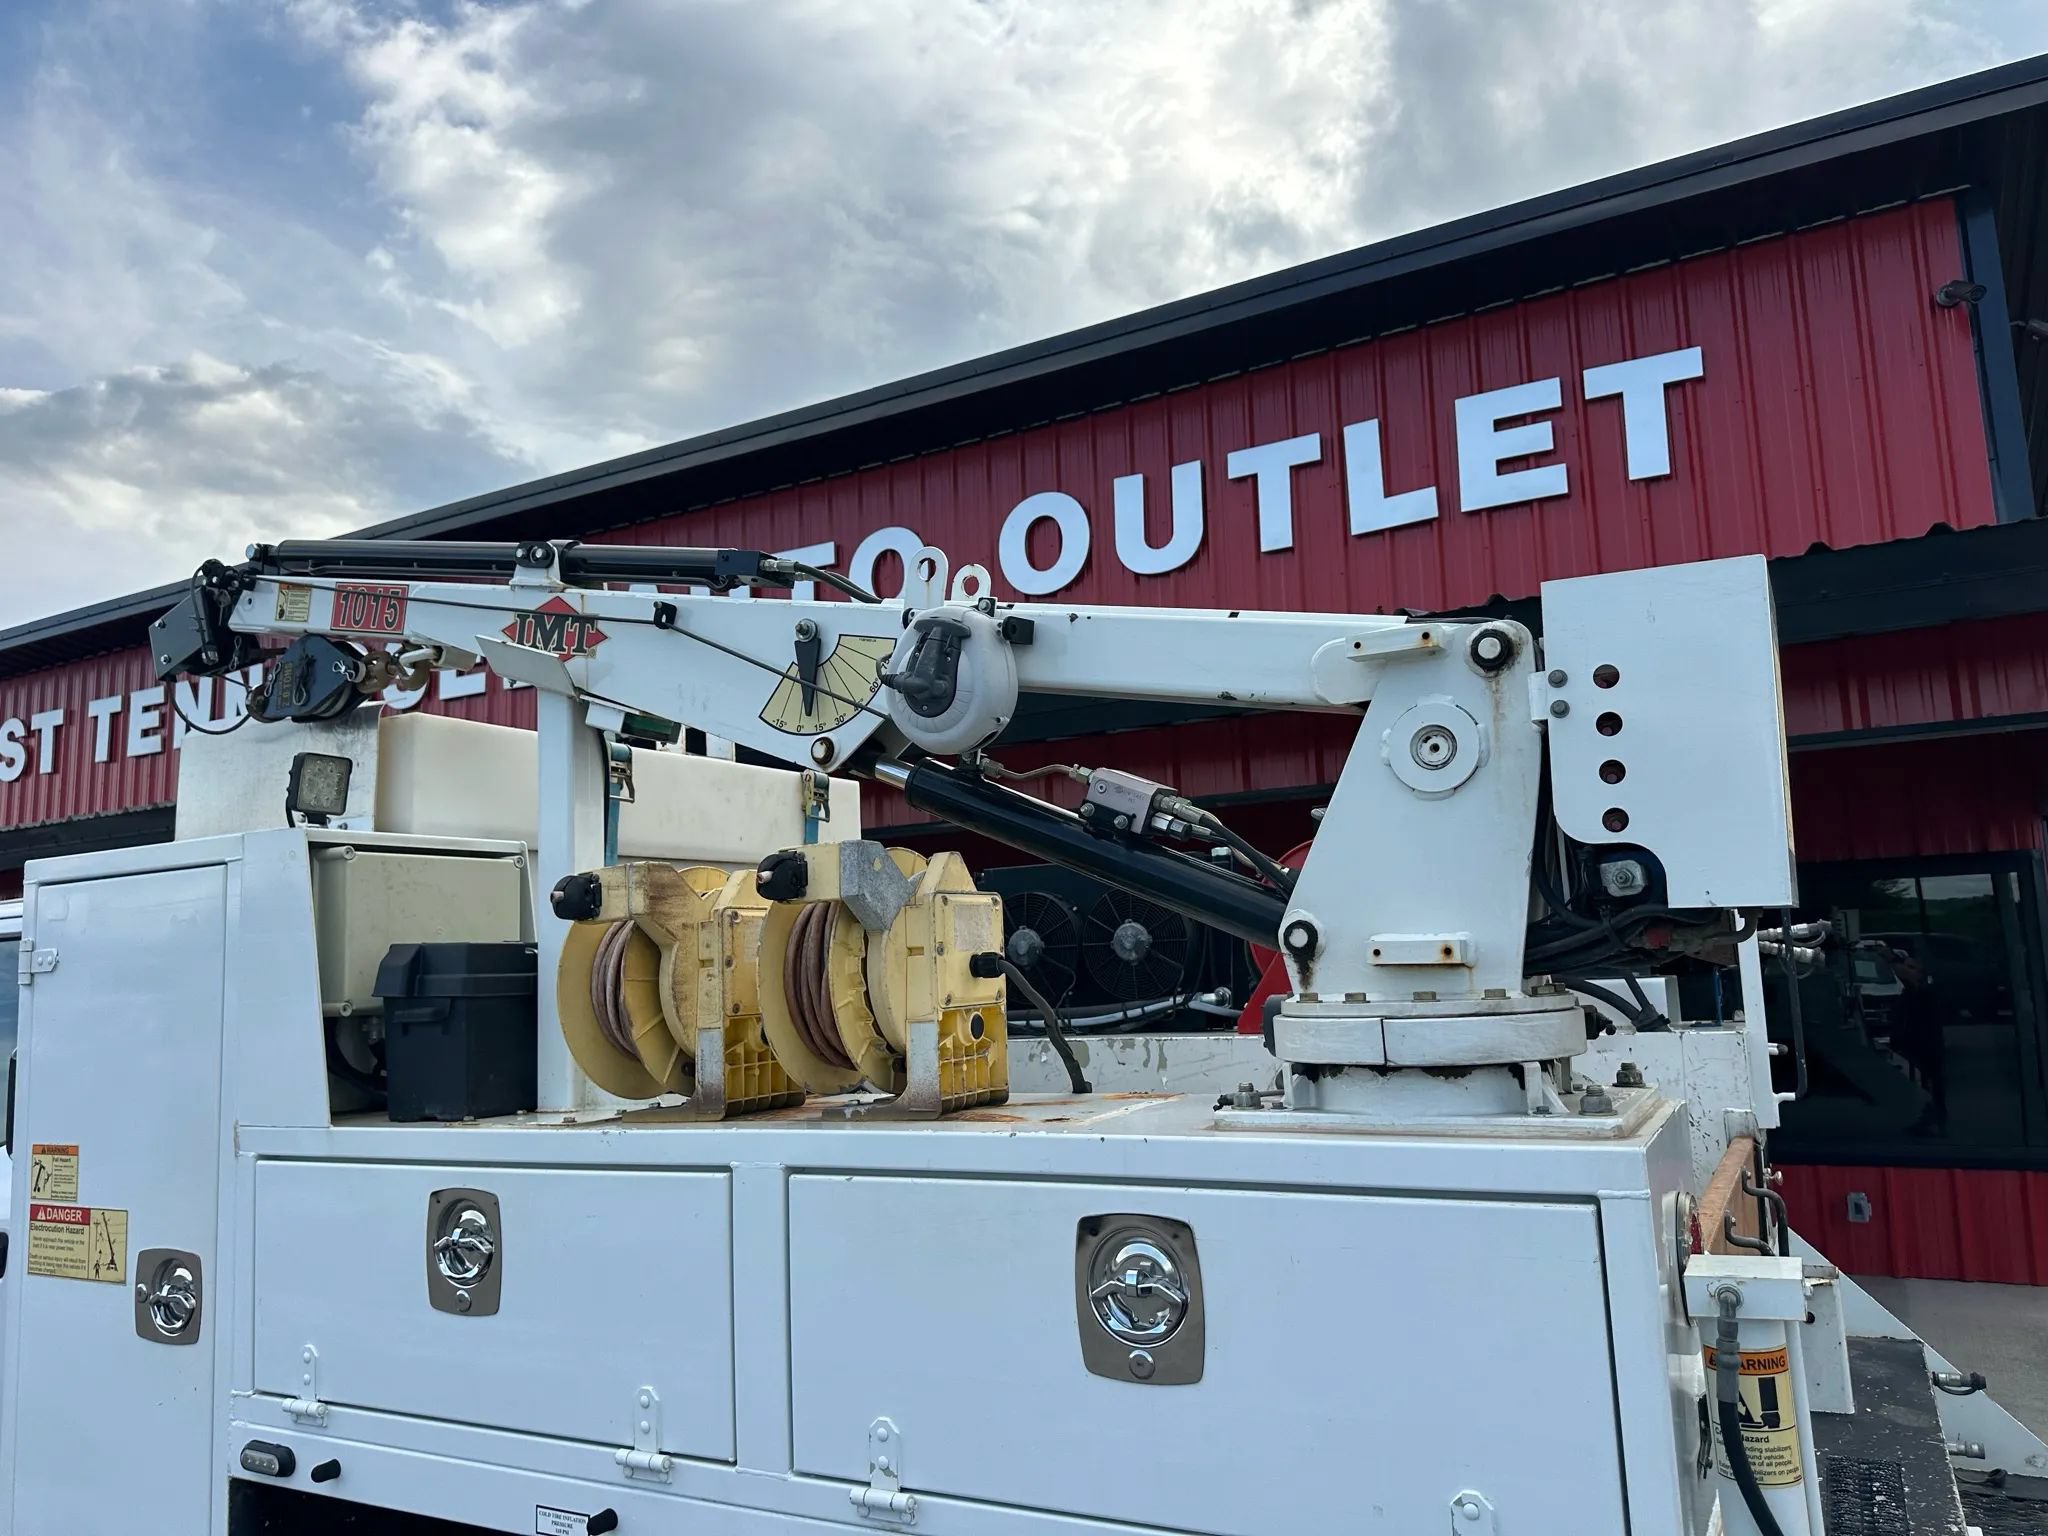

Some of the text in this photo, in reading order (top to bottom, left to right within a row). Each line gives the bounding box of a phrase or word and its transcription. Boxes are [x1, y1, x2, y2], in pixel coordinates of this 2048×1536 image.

[998, 346, 1704, 596] OUTLET
[340, 587, 401, 630] 1015
[515, 612, 597, 655] IMT
[814, 722, 827, 732] 15°
[833, 712, 847, 726] 30°
[46, 1208, 82, 1222] DANGER
[30, 1223, 84, 1235] Electrocution Hazard
[1740, 1355, 1786, 1371] ARNING
[551, 1520, 573, 1529] PRESSURE
